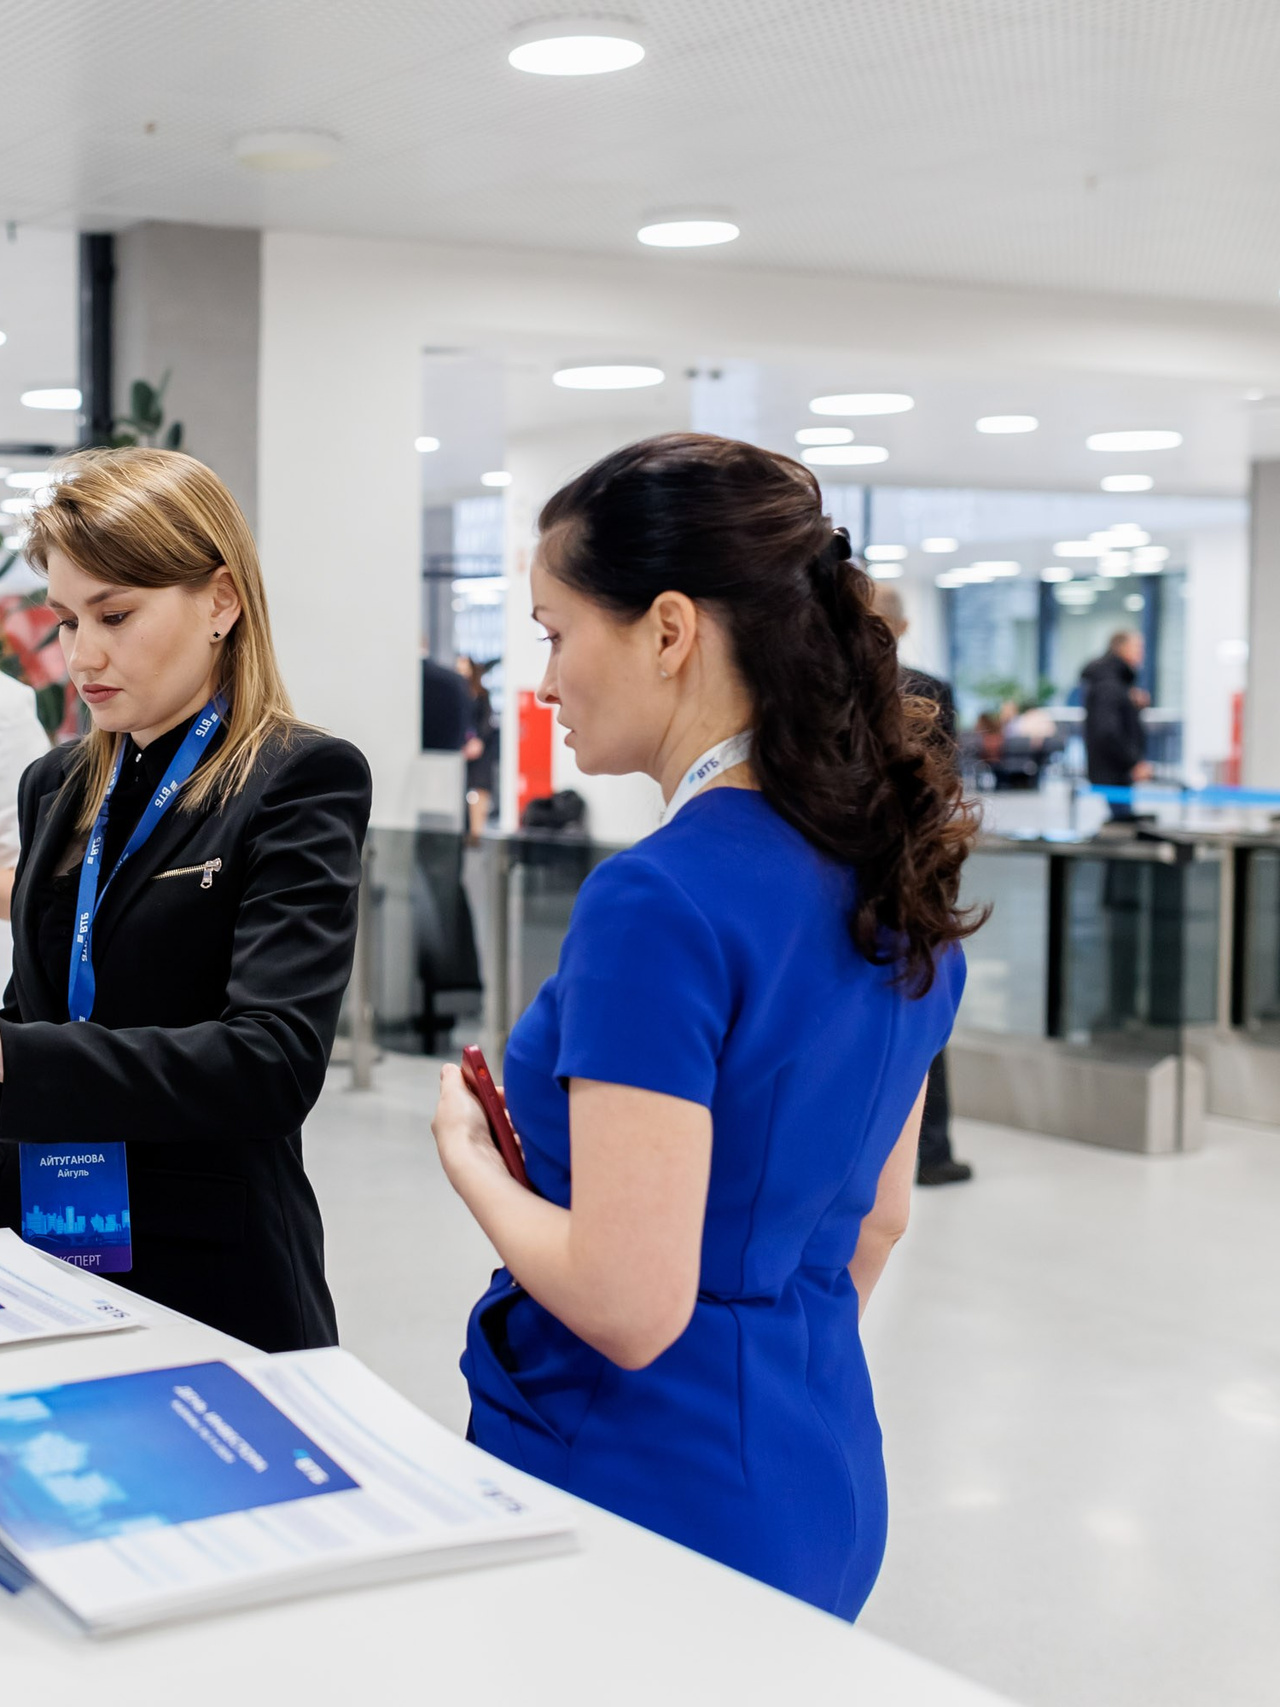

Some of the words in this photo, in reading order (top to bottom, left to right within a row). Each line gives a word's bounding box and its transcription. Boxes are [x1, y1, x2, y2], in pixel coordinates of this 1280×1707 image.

[195, 718, 213, 738] ВТБ
[696, 756, 719, 779] ВТБ
[154, 786, 172, 808] ВТБ
[90, 836, 102, 856] ВТБ
[79, 912, 90, 934] ВТБ
[39, 1154, 105, 1167] АЙТУГАНОВА
[57, 1168, 90, 1179] Айгуль
[59, 1254, 102, 1267] СПЕРТ
